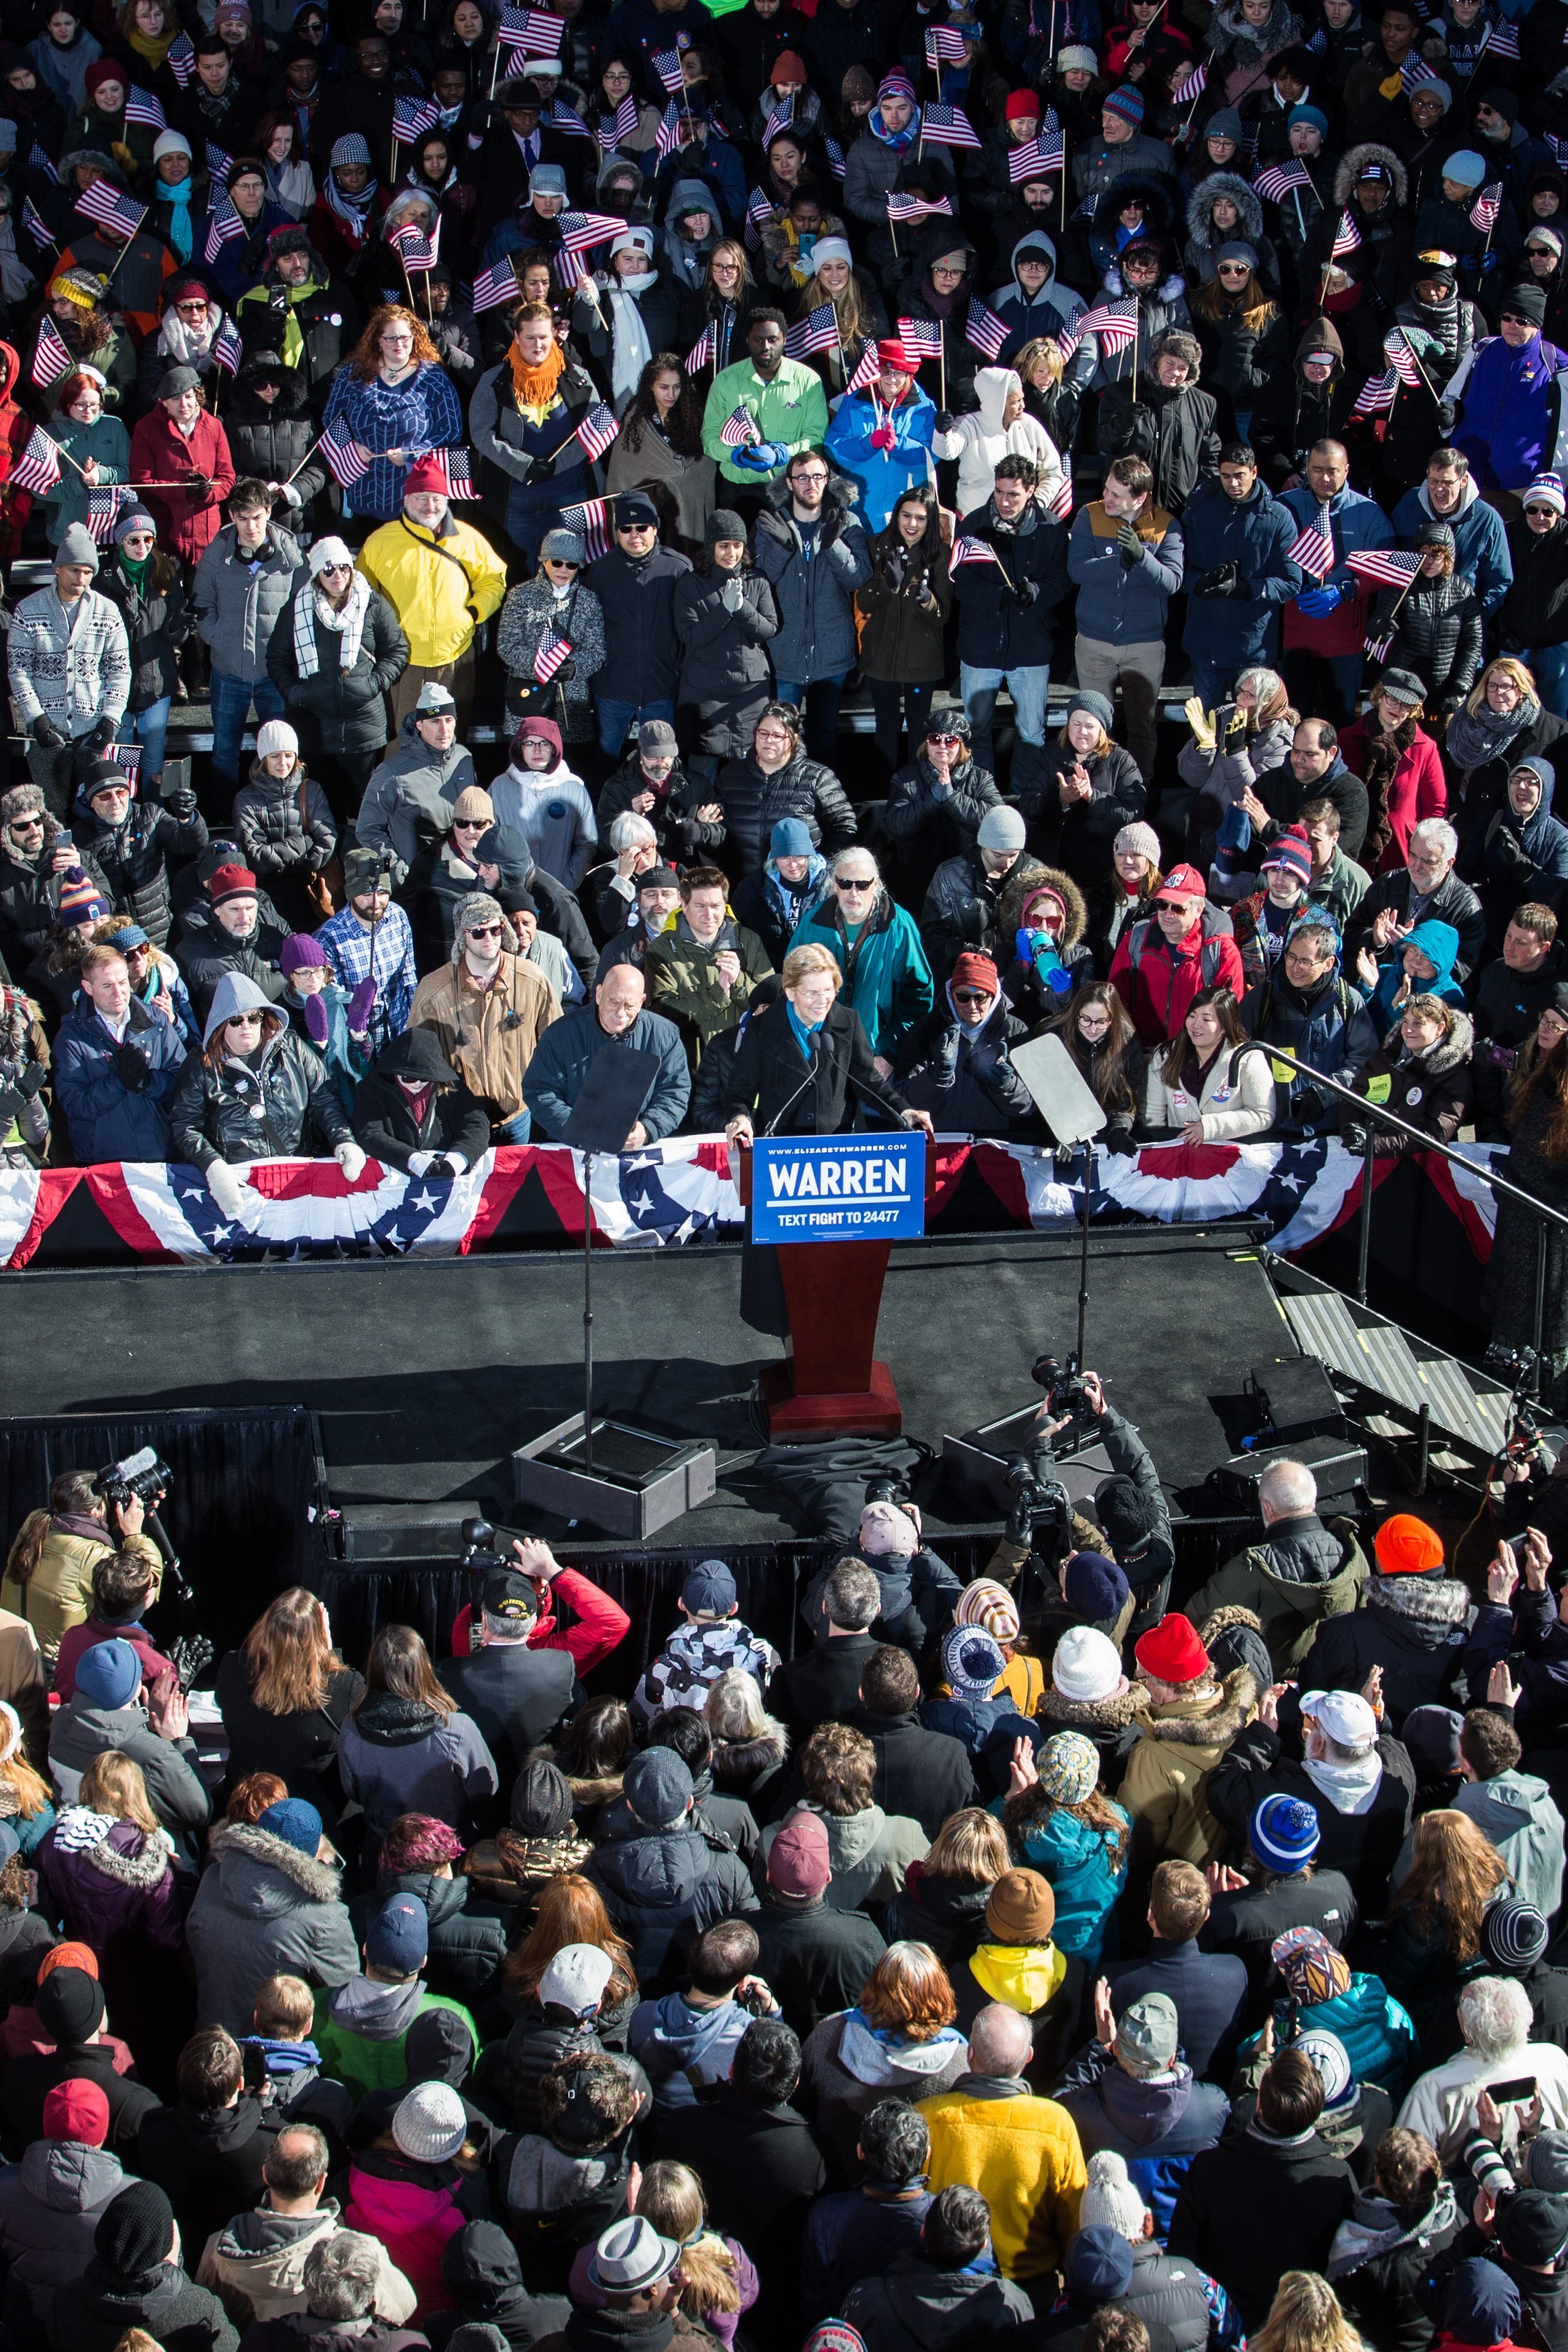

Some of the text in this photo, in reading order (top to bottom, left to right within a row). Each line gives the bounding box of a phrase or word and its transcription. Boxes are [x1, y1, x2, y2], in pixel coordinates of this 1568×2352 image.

[768, 1144, 907, 1155] WWW.ELIZABETHWARREN.COM
[768, 1158, 907, 1197] WARREN
[778, 1210, 900, 1226] TEXT FIGHT TO 24477
